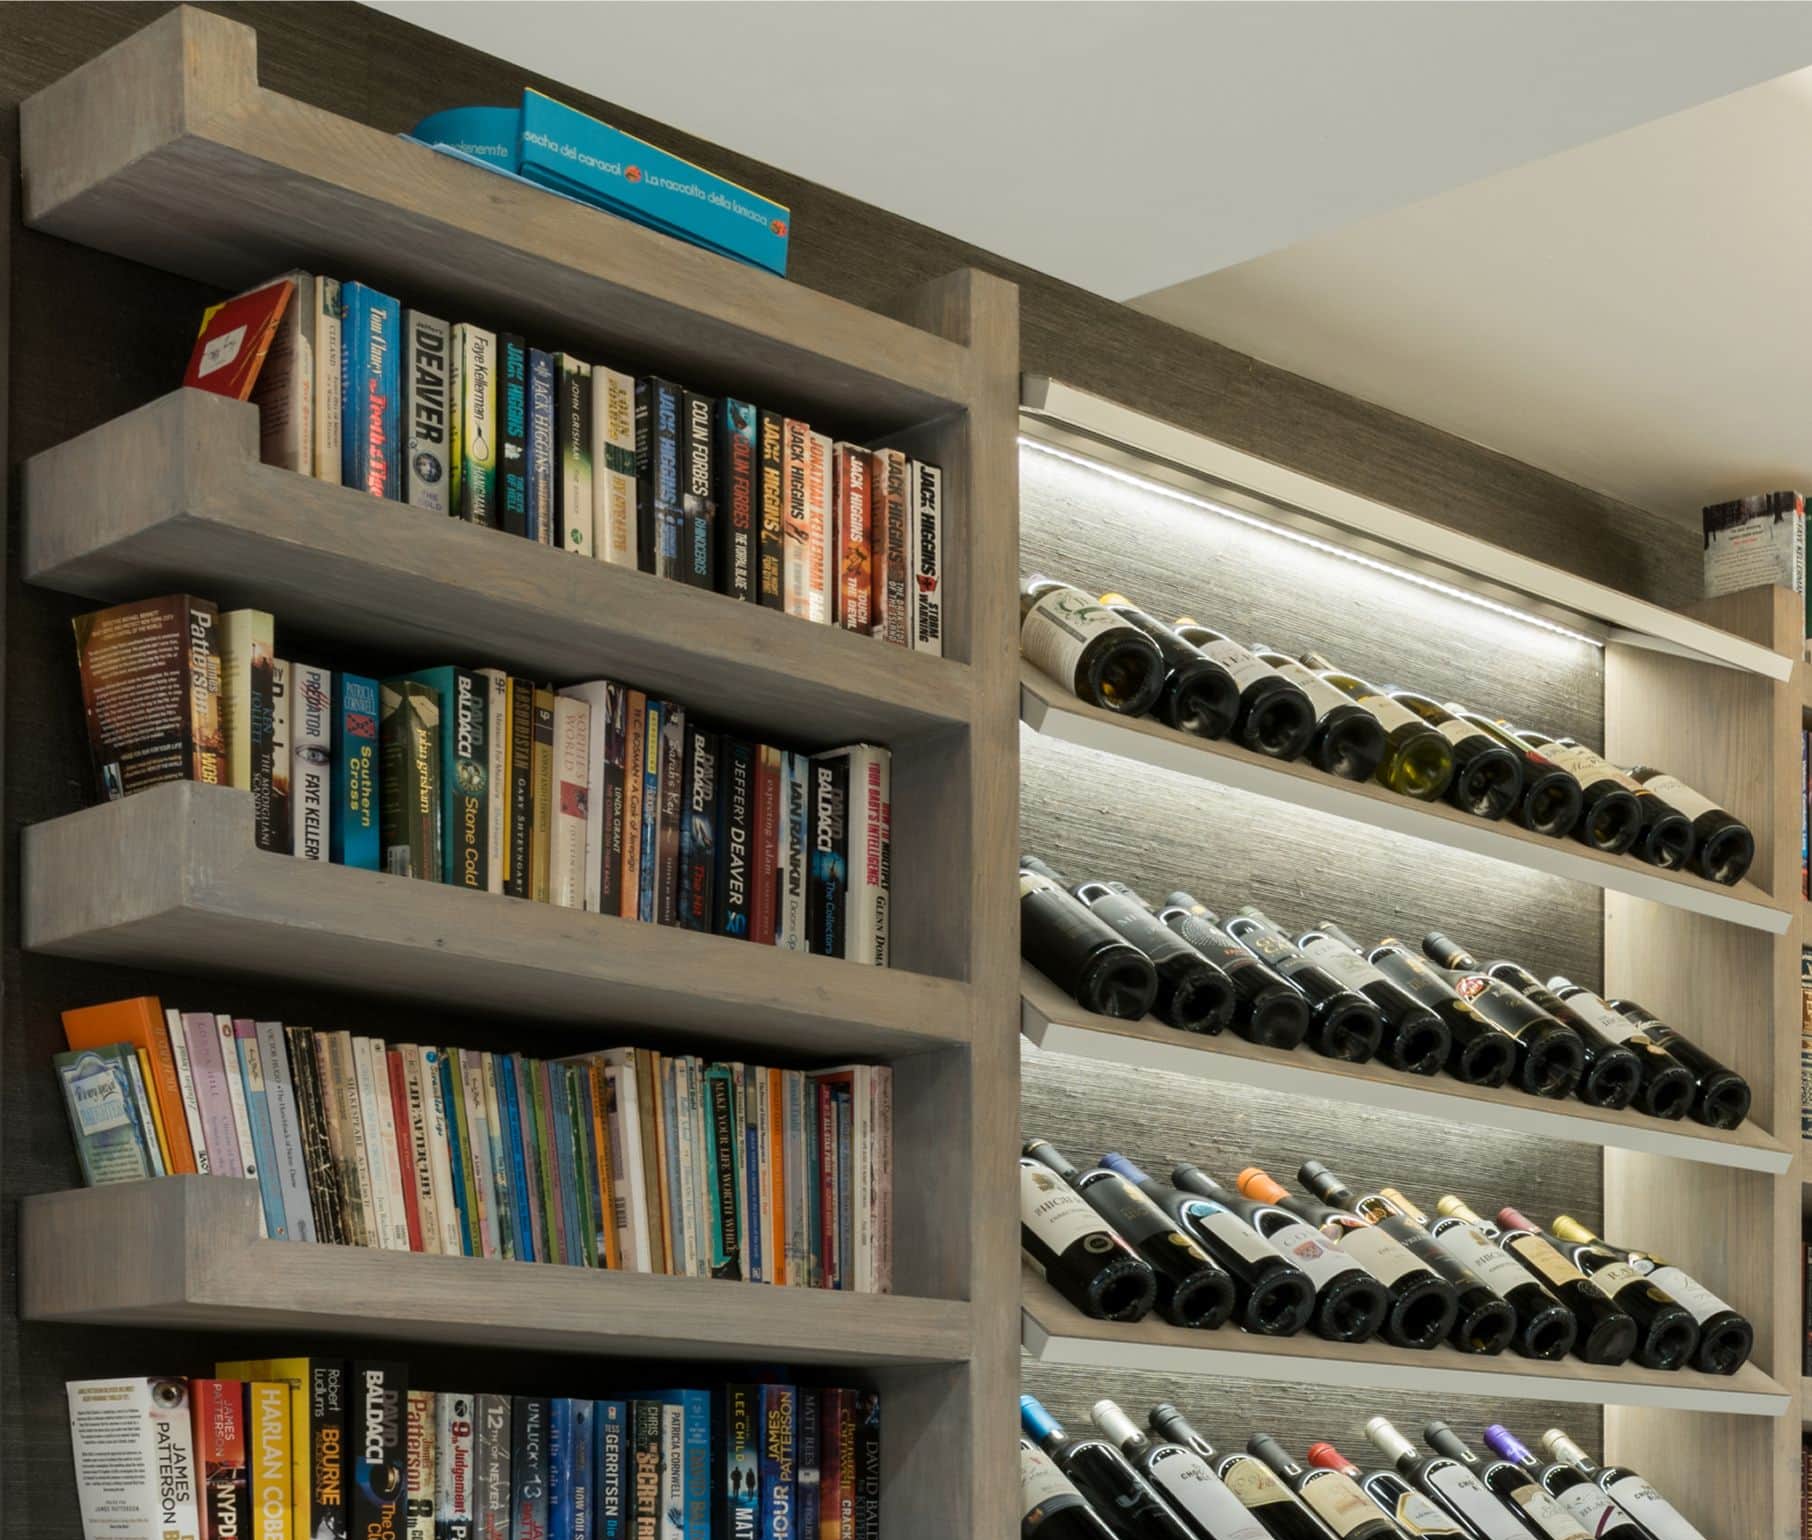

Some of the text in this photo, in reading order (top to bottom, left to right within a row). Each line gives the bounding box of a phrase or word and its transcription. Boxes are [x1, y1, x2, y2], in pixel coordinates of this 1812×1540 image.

[370, 307, 387, 333] Tom
[415, 329, 444, 445] DEAVER
[472, 336, 489, 421] Faye Kellerman
[507, 343, 524, 439] JACK HIGGINS
[571, 380, 581, 410] JOHN
[534, 379, 551, 474] JACK HIGGINS
[570, 413, 581, 461] GRISHAM
[659, 387, 676, 507] JACK HIGGINS
[692, 400, 709, 497] COLIN FORBES
[473, 465, 489, 514] HANGMAN
[732, 432, 750, 529] COLIN FORBES
[763, 417, 781, 532] JACK HIGGINS
[791, 426, 806, 520] JACK HIGGINS
[850, 456, 864, 542] JACK HIGGINS
[887, 453, 904, 562] JACK HIGGINS
[810, 437, 825, 592] JONATHAN KELLERMAN
[919, 466, 938, 576] JACK HIGGINS
[847, 577, 858, 629] THE DEVIL
[858, 590, 869, 624] TOUCH
[918, 594, 930, 643] WARNING
[928, 603, 940, 639] STORM
[189, 609, 215, 715] Patterson
[458, 676, 472, 758] BALDACCI
[304, 773, 321, 804] FAYE
[349, 758, 362, 811] Cross
[360, 746, 374, 827] Southern
[416, 728, 433, 813] john grisham
[614, 787, 623, 816] LINDA
[663, 792, 681, 816] Key
[692, 734, 705, 812] BALDACCI
[817, 767, 833, 852] BALDACCI
[464, 796, 480, 885] Stone Cold
[729, 760, 747, 904] JEFFERY DEAVER
[789, 781, 803, 896] IAN RANKIN
[867, 823, 881, 887] INTELLIGENCE
[716, 1081, 731, 1171] MAKE YOUR LIFE
[212, 1383, 226, 1457] PATTERSON
[223, 1399, 236, 1441] JAMES
[327, 1369, 342, 1412] Robert
[365, 1370, 384, 1465] BALDACCI
[383, 1390, 400, 1448] DAVID
[648, 1407, 659, 1436] CHRIS
[735, 1392, 745, 1461] LEE CHILD
[156, 1421, 178, 1524] PATTERSON
[171, 1443, 190, 1502] JAMES
[260, 1388, 284, 1479] HARLAN
[321, 1427, 342, 1505] BOURNE
[406, 1398, 428, 1491] Patterson
[523, 1402, 542, 1499] UNLUCKY 13
[671, 1412, 681, 1499] PATRICIA CORNWELL
[768, 1410, 780, 1462] JAMES
[780, 1391, 793, 1482] PATTERSON
[215, 1484, 238, 1536] NYPD
[381, 1503, 397, 1528] The
[451, 1445, 469, 1514] Judgement
[489, 1462, 501, 1510] NEVER
[575, 1486, 585, 1510] NOW
[604, 1434, 619, 1516] GERRITSEN
